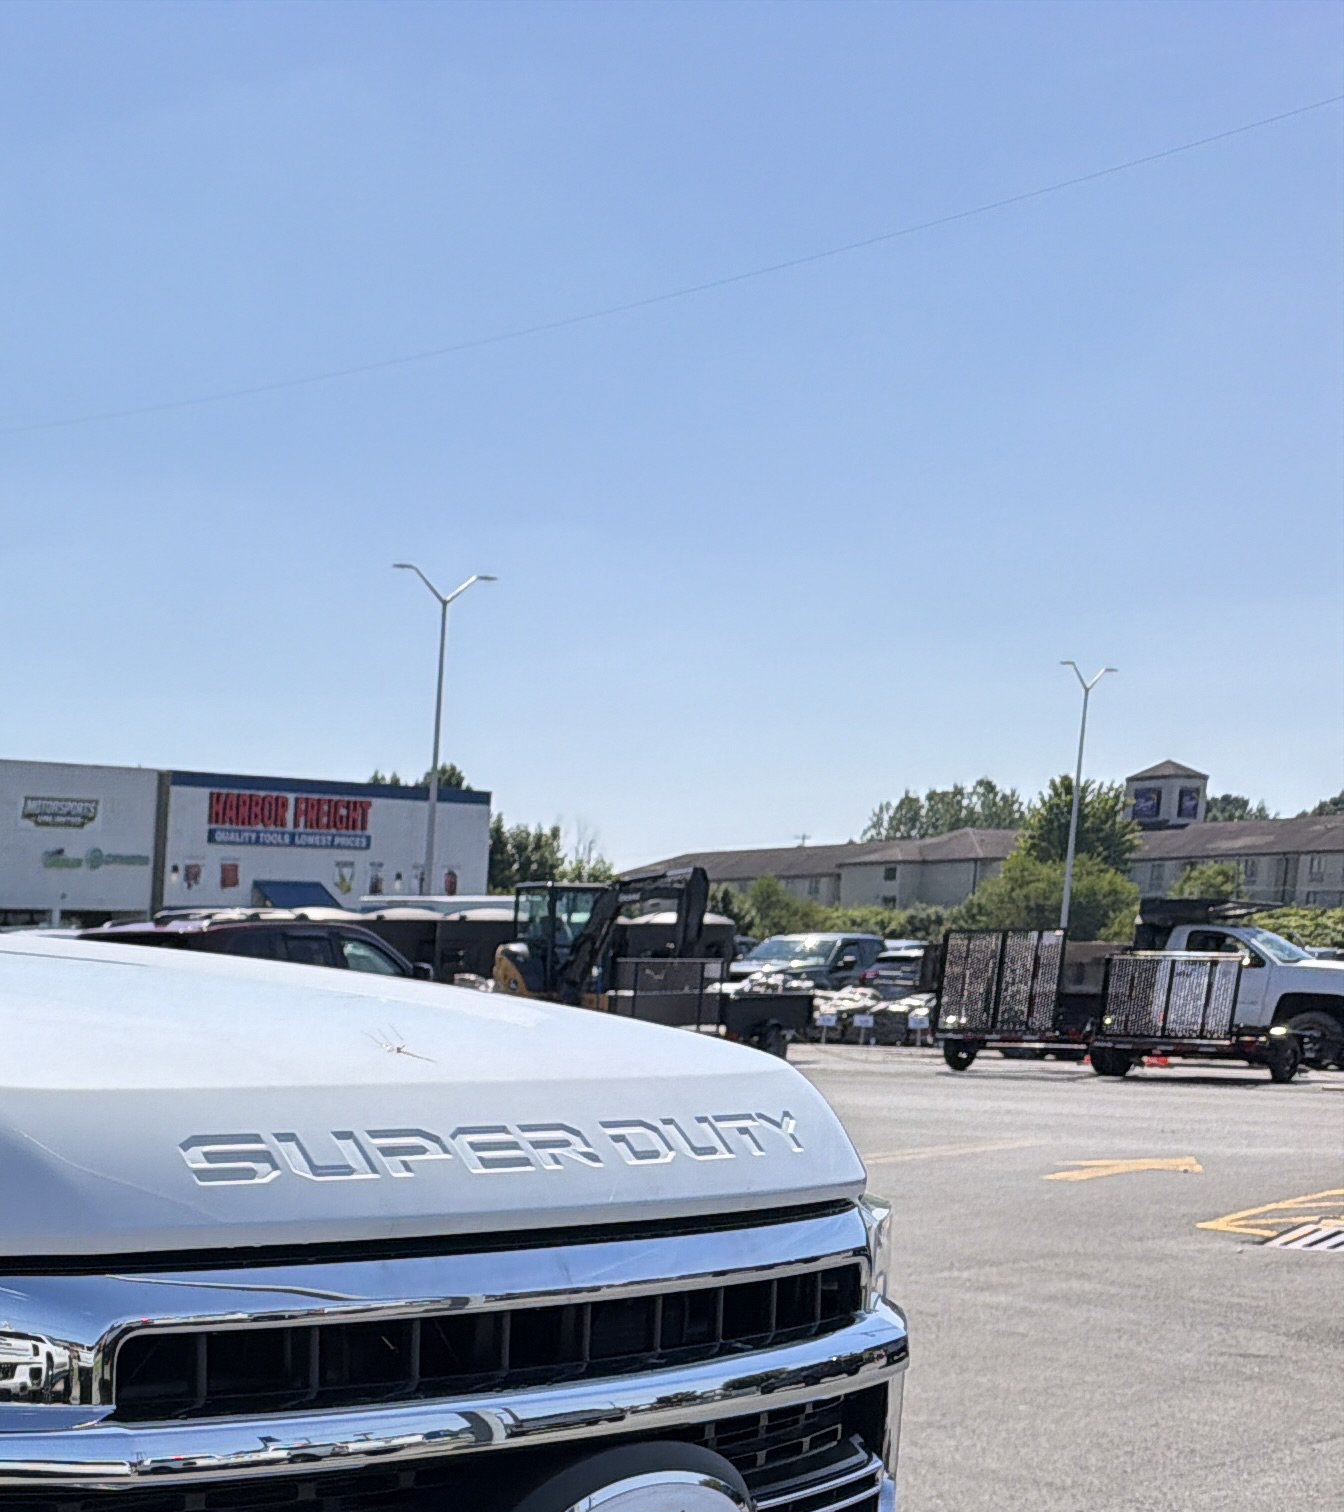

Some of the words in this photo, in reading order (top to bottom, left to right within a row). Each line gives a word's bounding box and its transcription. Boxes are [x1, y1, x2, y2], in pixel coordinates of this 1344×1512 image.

[208, 791, 289, 828] HARBOR
[293, 796, 372, 832] FREIGHT
[214, 831, 257, 843] QUALITY
[260, 833, 290, 844] TOOLS
[176, 1123, 604, 1187] SUPER
[598, 1110, 805, 1165] DUTY
